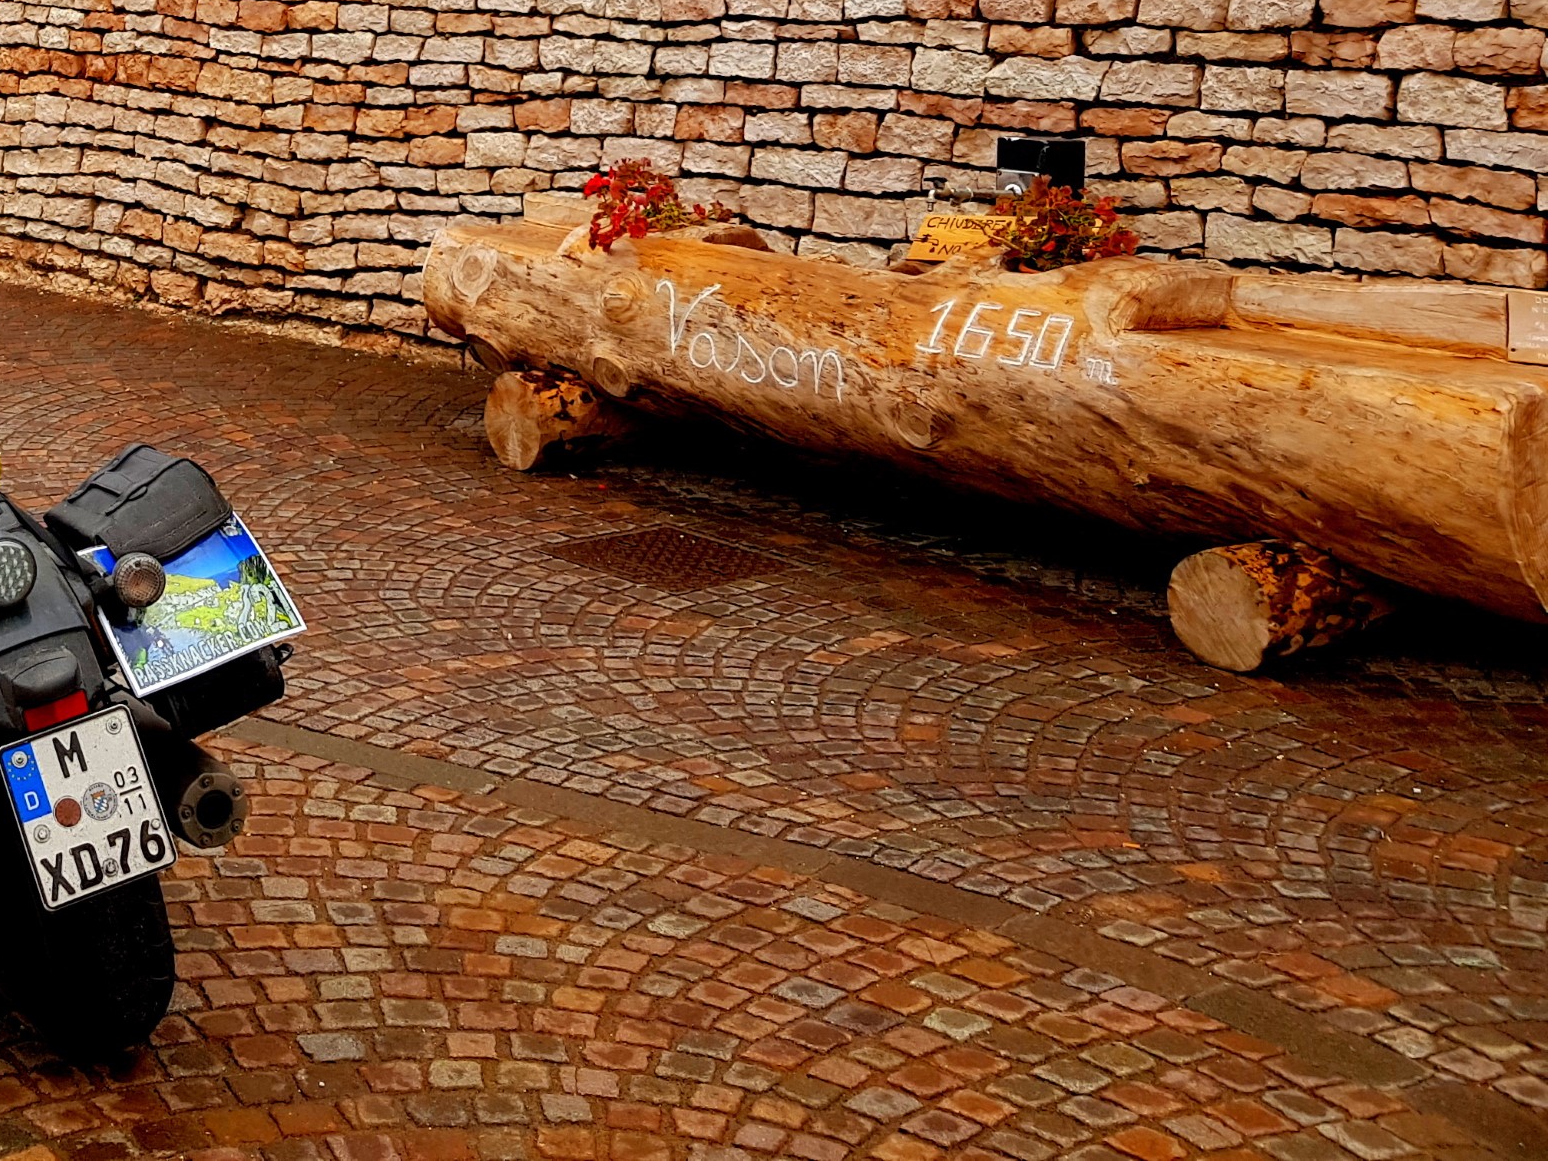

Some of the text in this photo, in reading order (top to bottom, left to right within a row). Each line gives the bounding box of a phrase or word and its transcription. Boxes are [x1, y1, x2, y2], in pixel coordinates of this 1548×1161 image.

[654, 278, 848, 404] Vason
[916, 298, 1075, 370] 1650
[133, 619, 273, 687] PASSKNACKER.COM
[52, 730, 88, 779] M
[113, 766, 139, 788] 03
[24, 791, 40, 811] D
[124, 793, 147, 815] 11
[40, 819, 166, 902] XD 76
